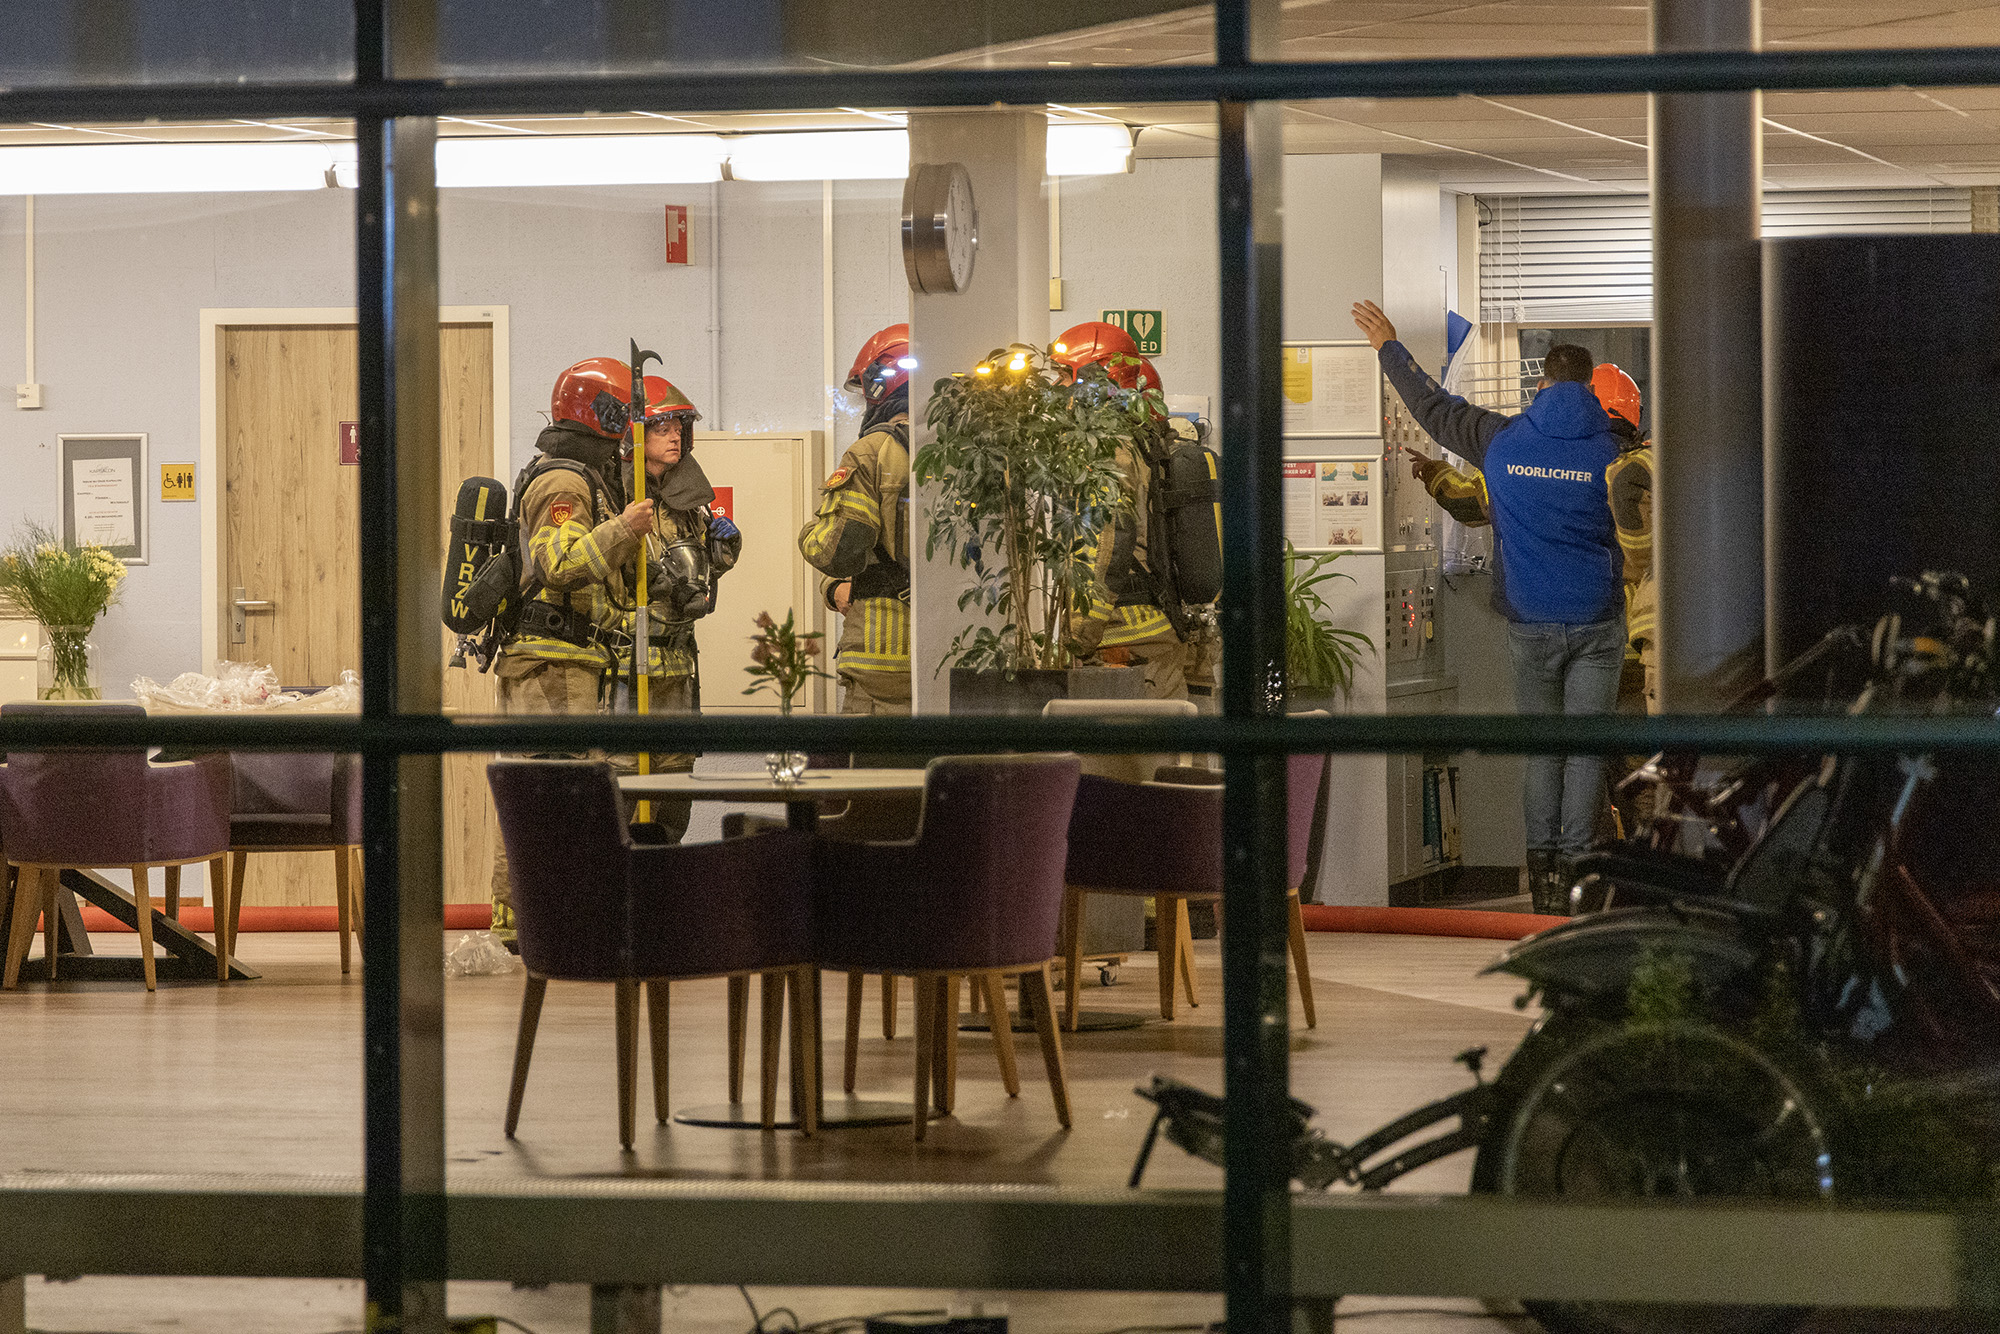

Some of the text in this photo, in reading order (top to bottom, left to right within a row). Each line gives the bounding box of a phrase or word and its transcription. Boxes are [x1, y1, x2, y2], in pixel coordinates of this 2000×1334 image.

[1140, 341, 1158, 352] ED
[1506, 464, 1593, 482] VOORLICHTER
[450, 543, 479, 619] VRZW
